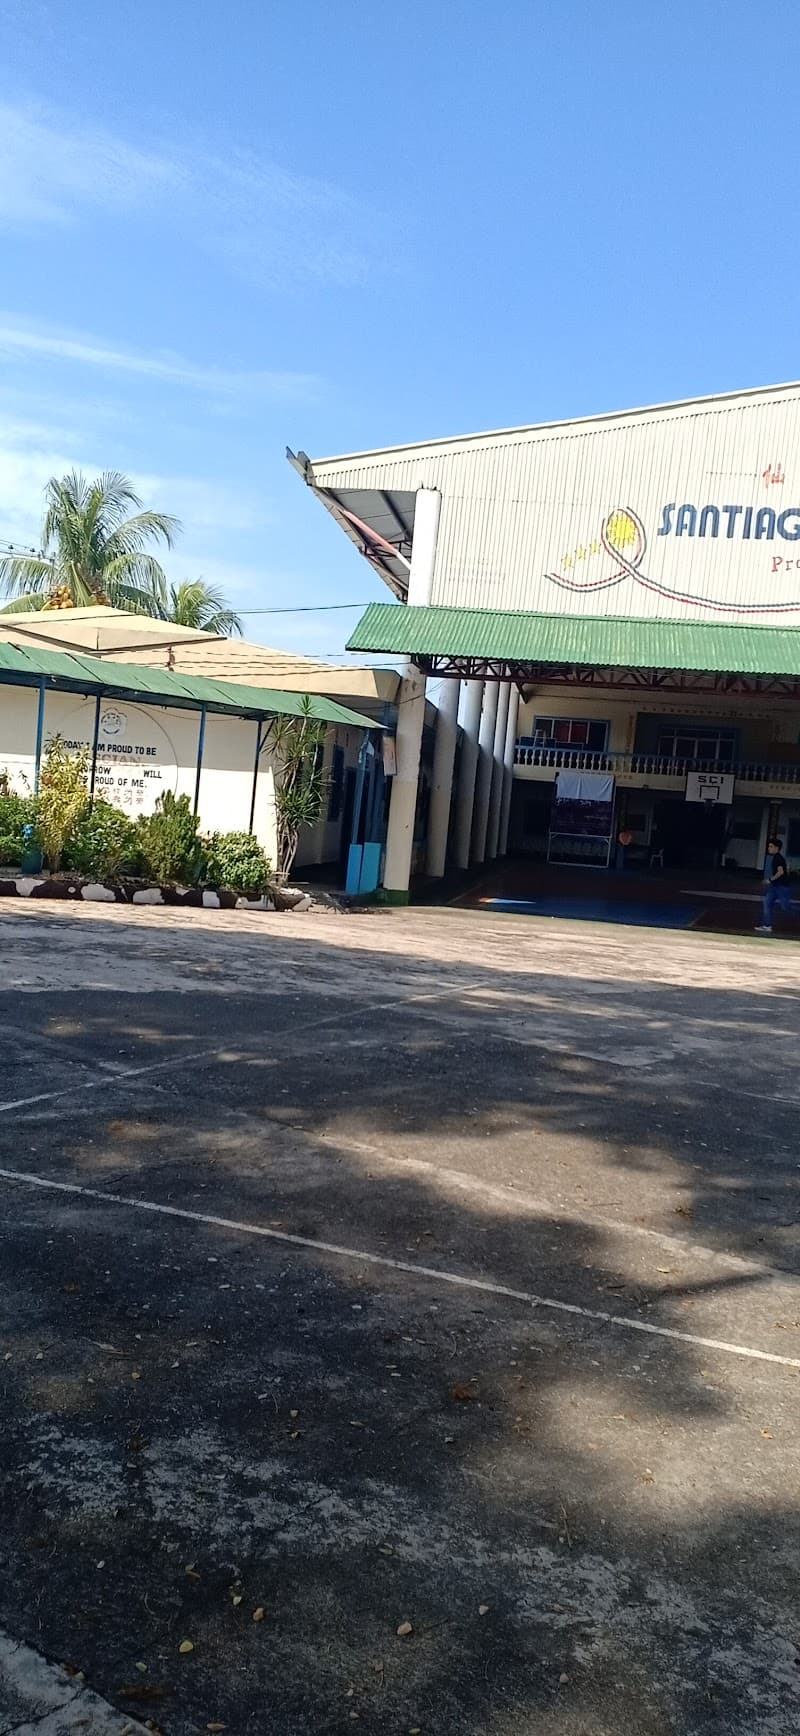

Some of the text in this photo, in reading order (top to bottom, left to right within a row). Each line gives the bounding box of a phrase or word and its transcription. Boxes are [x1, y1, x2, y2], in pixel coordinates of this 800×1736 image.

[63, 740, 84, 749] ODAY
[108, 744, 133, 754] PROUD
[135, 746, 145, 755] TO
[146, 747, 157, 756] BE
[143, 770, 162, 779] WILL
[697, 775, 724, 784] SCI
[95, 777, 114, 785] ROUD
[117, 778, 128, 786] OF
[131, 779, 148, 788] ME.
